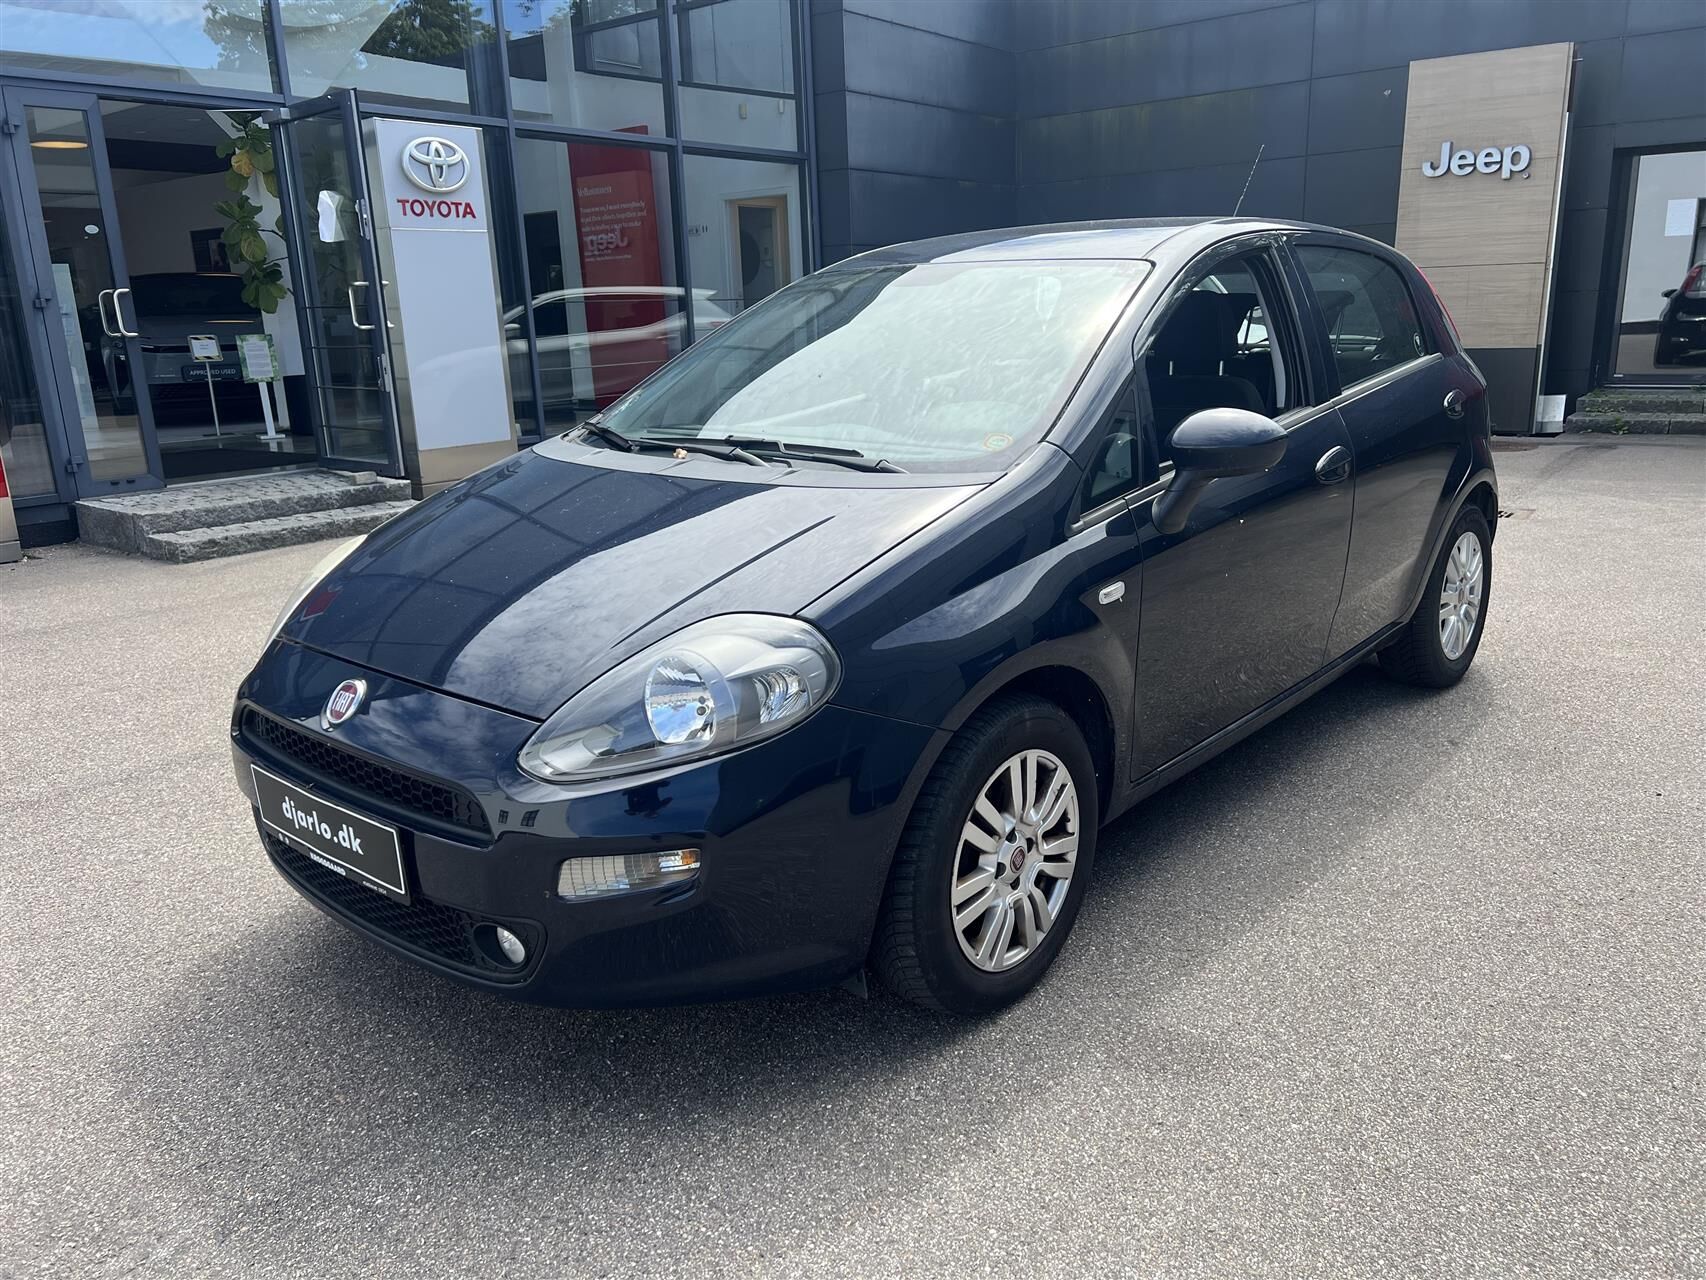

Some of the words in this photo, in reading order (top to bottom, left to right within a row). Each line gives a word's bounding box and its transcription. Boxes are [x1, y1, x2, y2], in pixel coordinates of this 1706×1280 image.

[1422, 141, 1531, 180] Jeep
[396, 198, 477, 219] TOYOTA
[332, 690, 356, 713] FIAT
[281, 796, 364, 855] djarlo.dk
